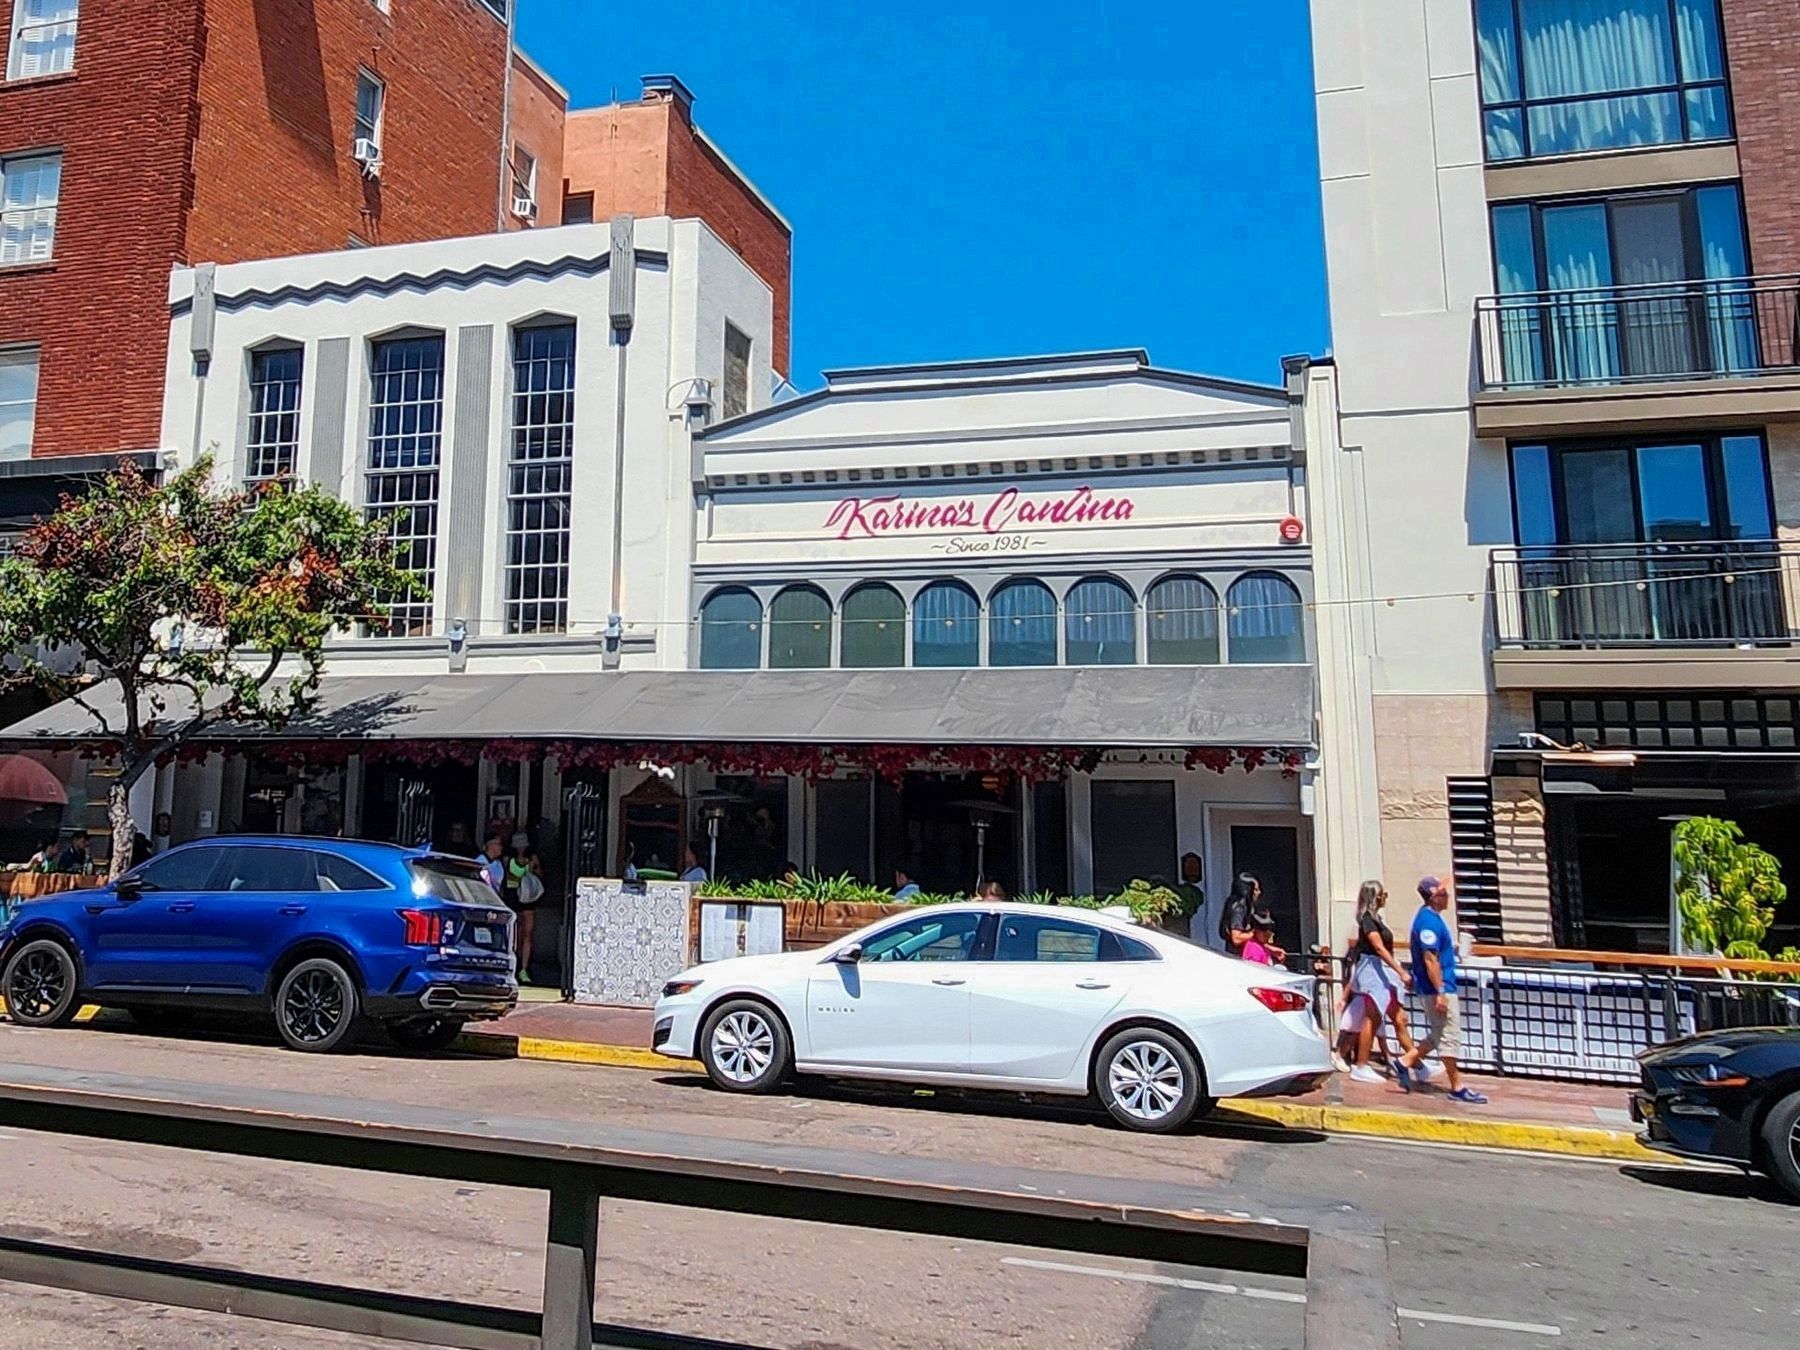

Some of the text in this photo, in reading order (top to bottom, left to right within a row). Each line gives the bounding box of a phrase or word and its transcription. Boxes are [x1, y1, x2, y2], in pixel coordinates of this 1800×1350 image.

[823, 486, 1135, 540] Karina's Cantina
[993, 535, 1030, 551] 1981
